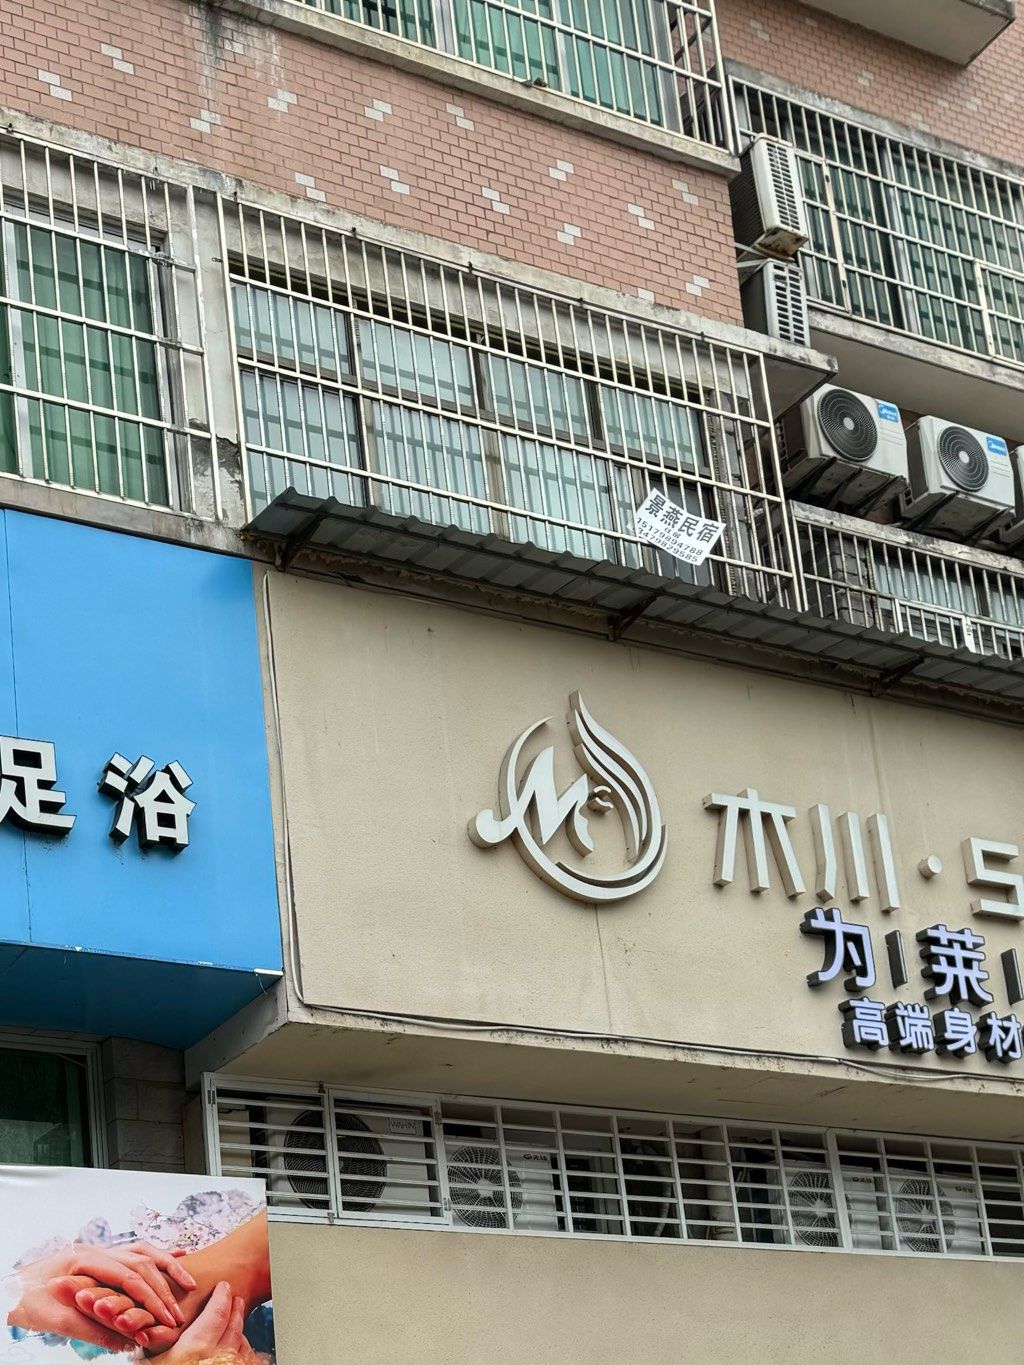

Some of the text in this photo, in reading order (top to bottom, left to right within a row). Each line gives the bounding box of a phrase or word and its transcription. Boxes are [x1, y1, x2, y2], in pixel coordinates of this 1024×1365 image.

[645, 494, 719, 543] 景燕民宿
[838, 996, 1024, 1064] 高端身材
